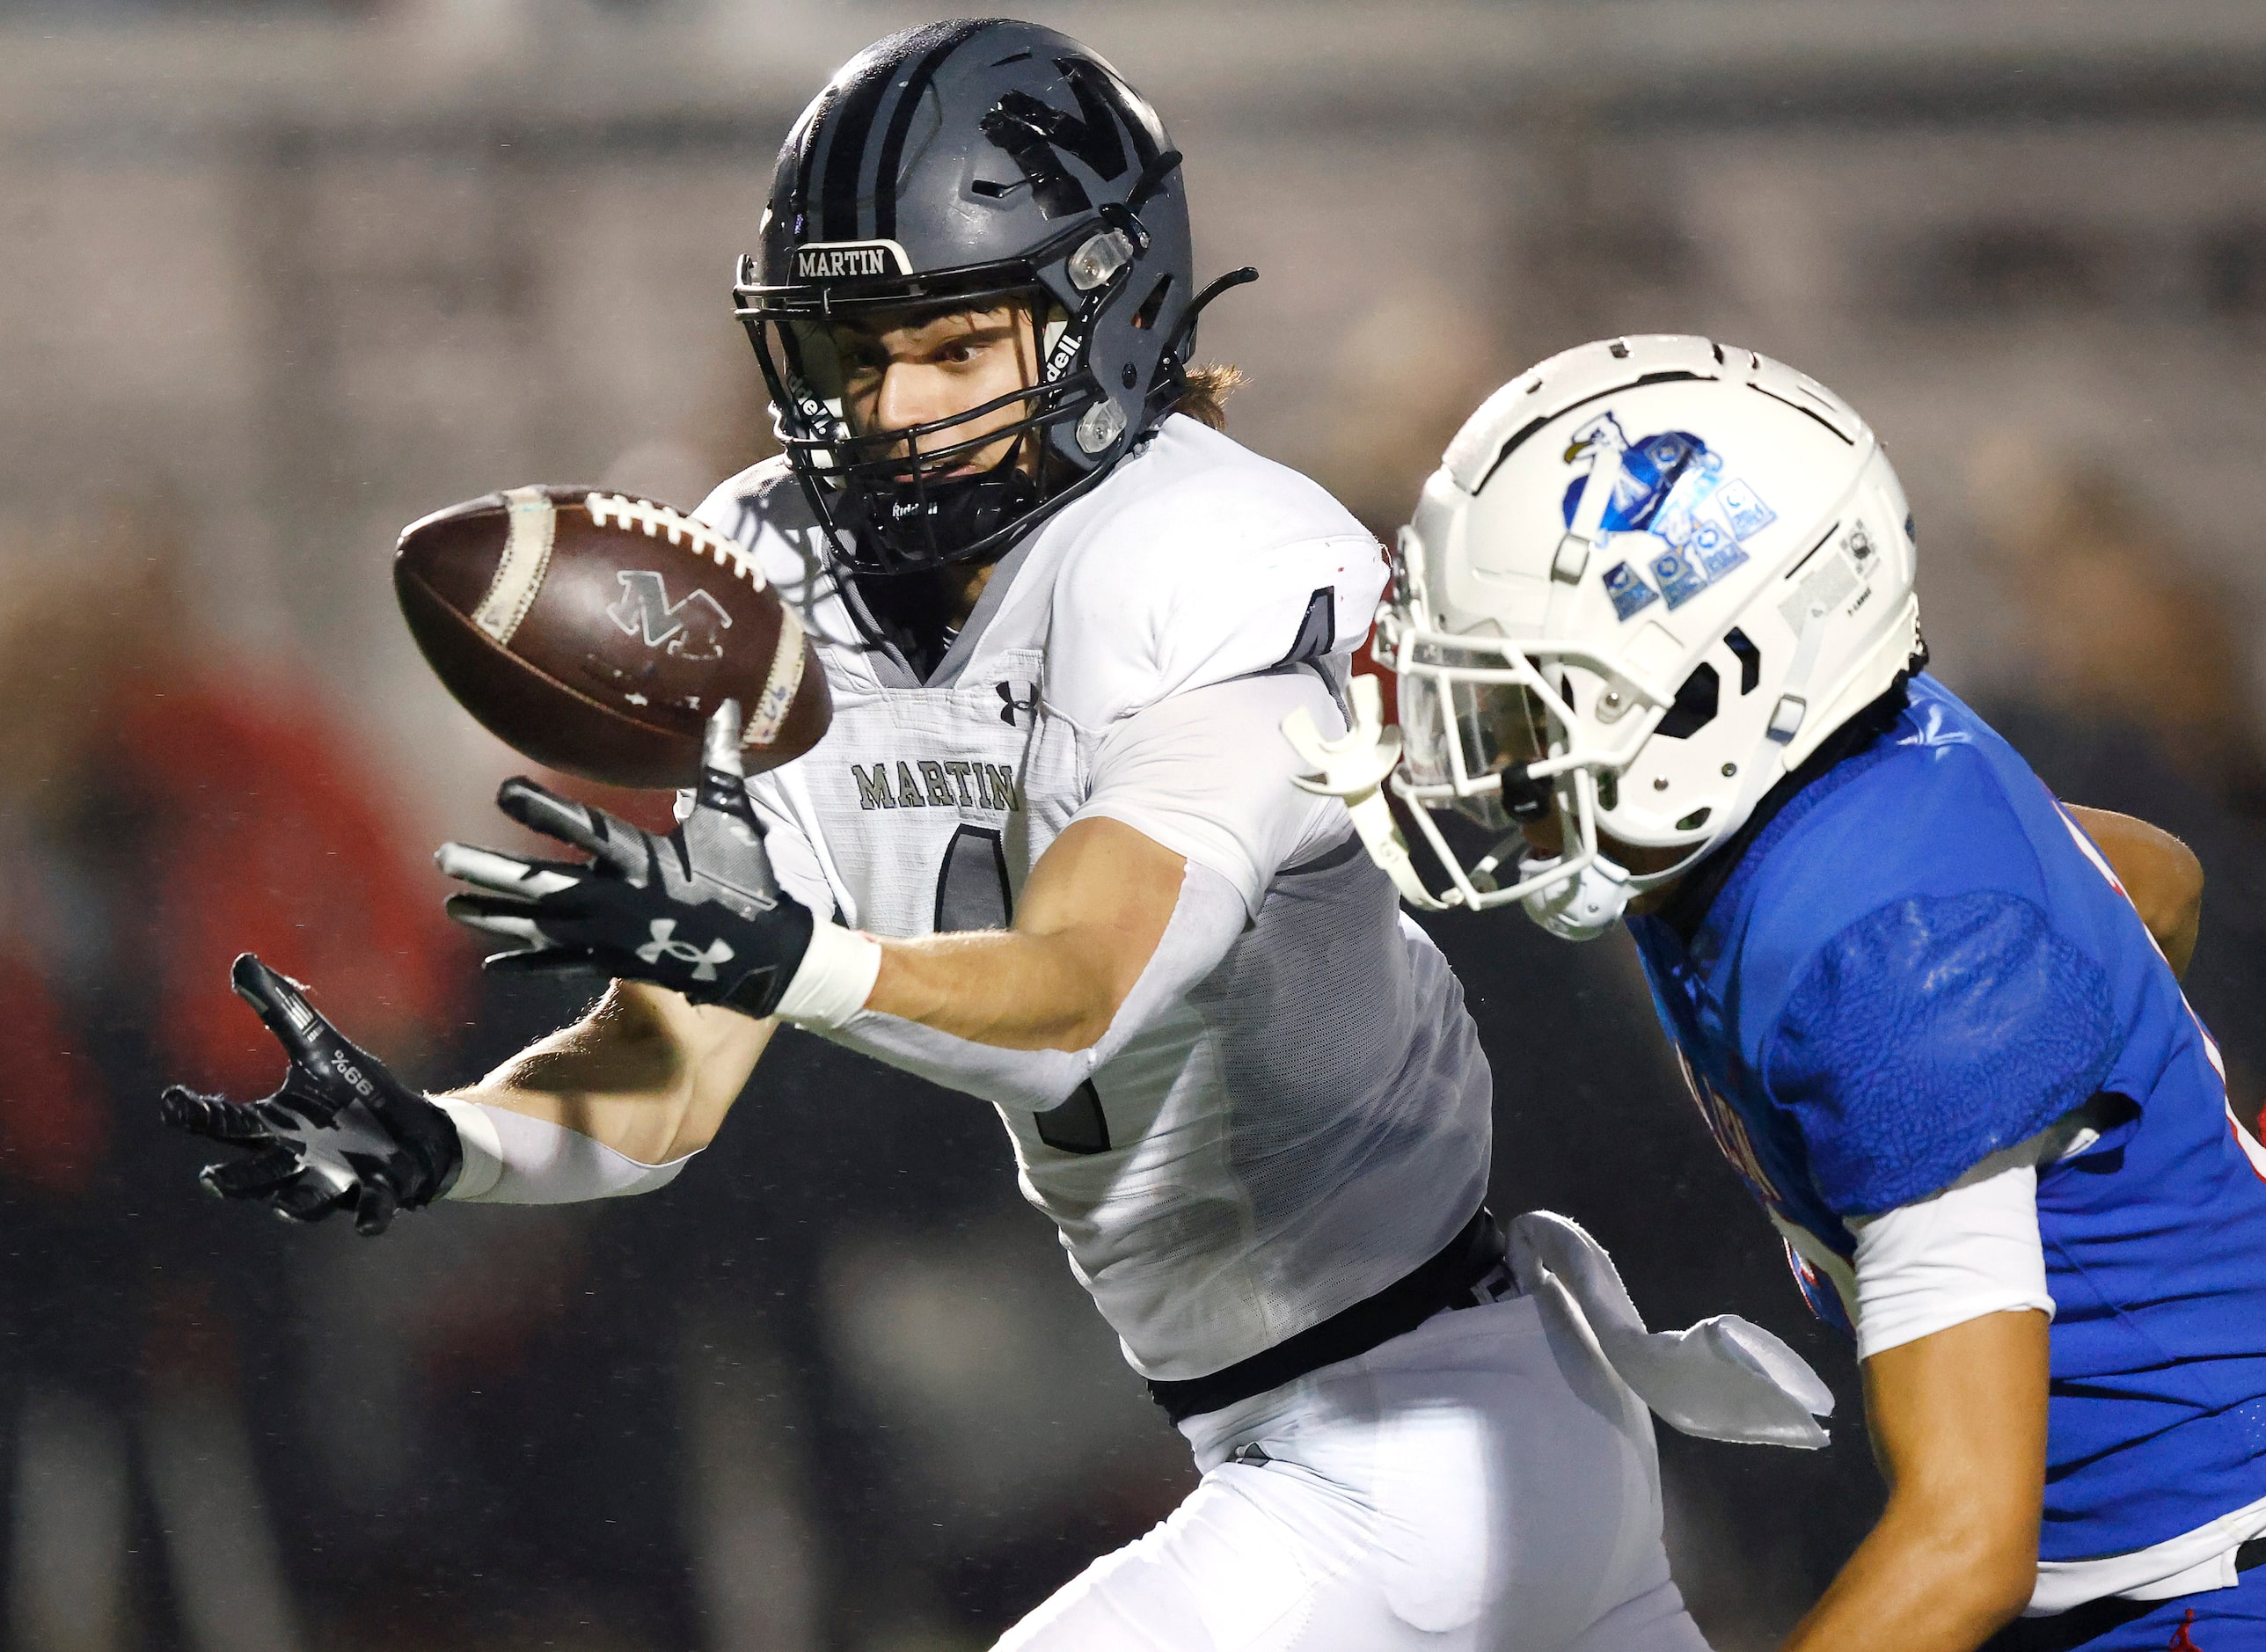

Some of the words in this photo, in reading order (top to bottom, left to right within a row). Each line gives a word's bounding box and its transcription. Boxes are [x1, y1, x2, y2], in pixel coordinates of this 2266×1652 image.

[799, 249, 884, 277] MARTIN
[1046, 334, 1082, 382] dell
[892, 501, 938, 517] Riddll
[851, 760, 1020, 811] MARTIN
